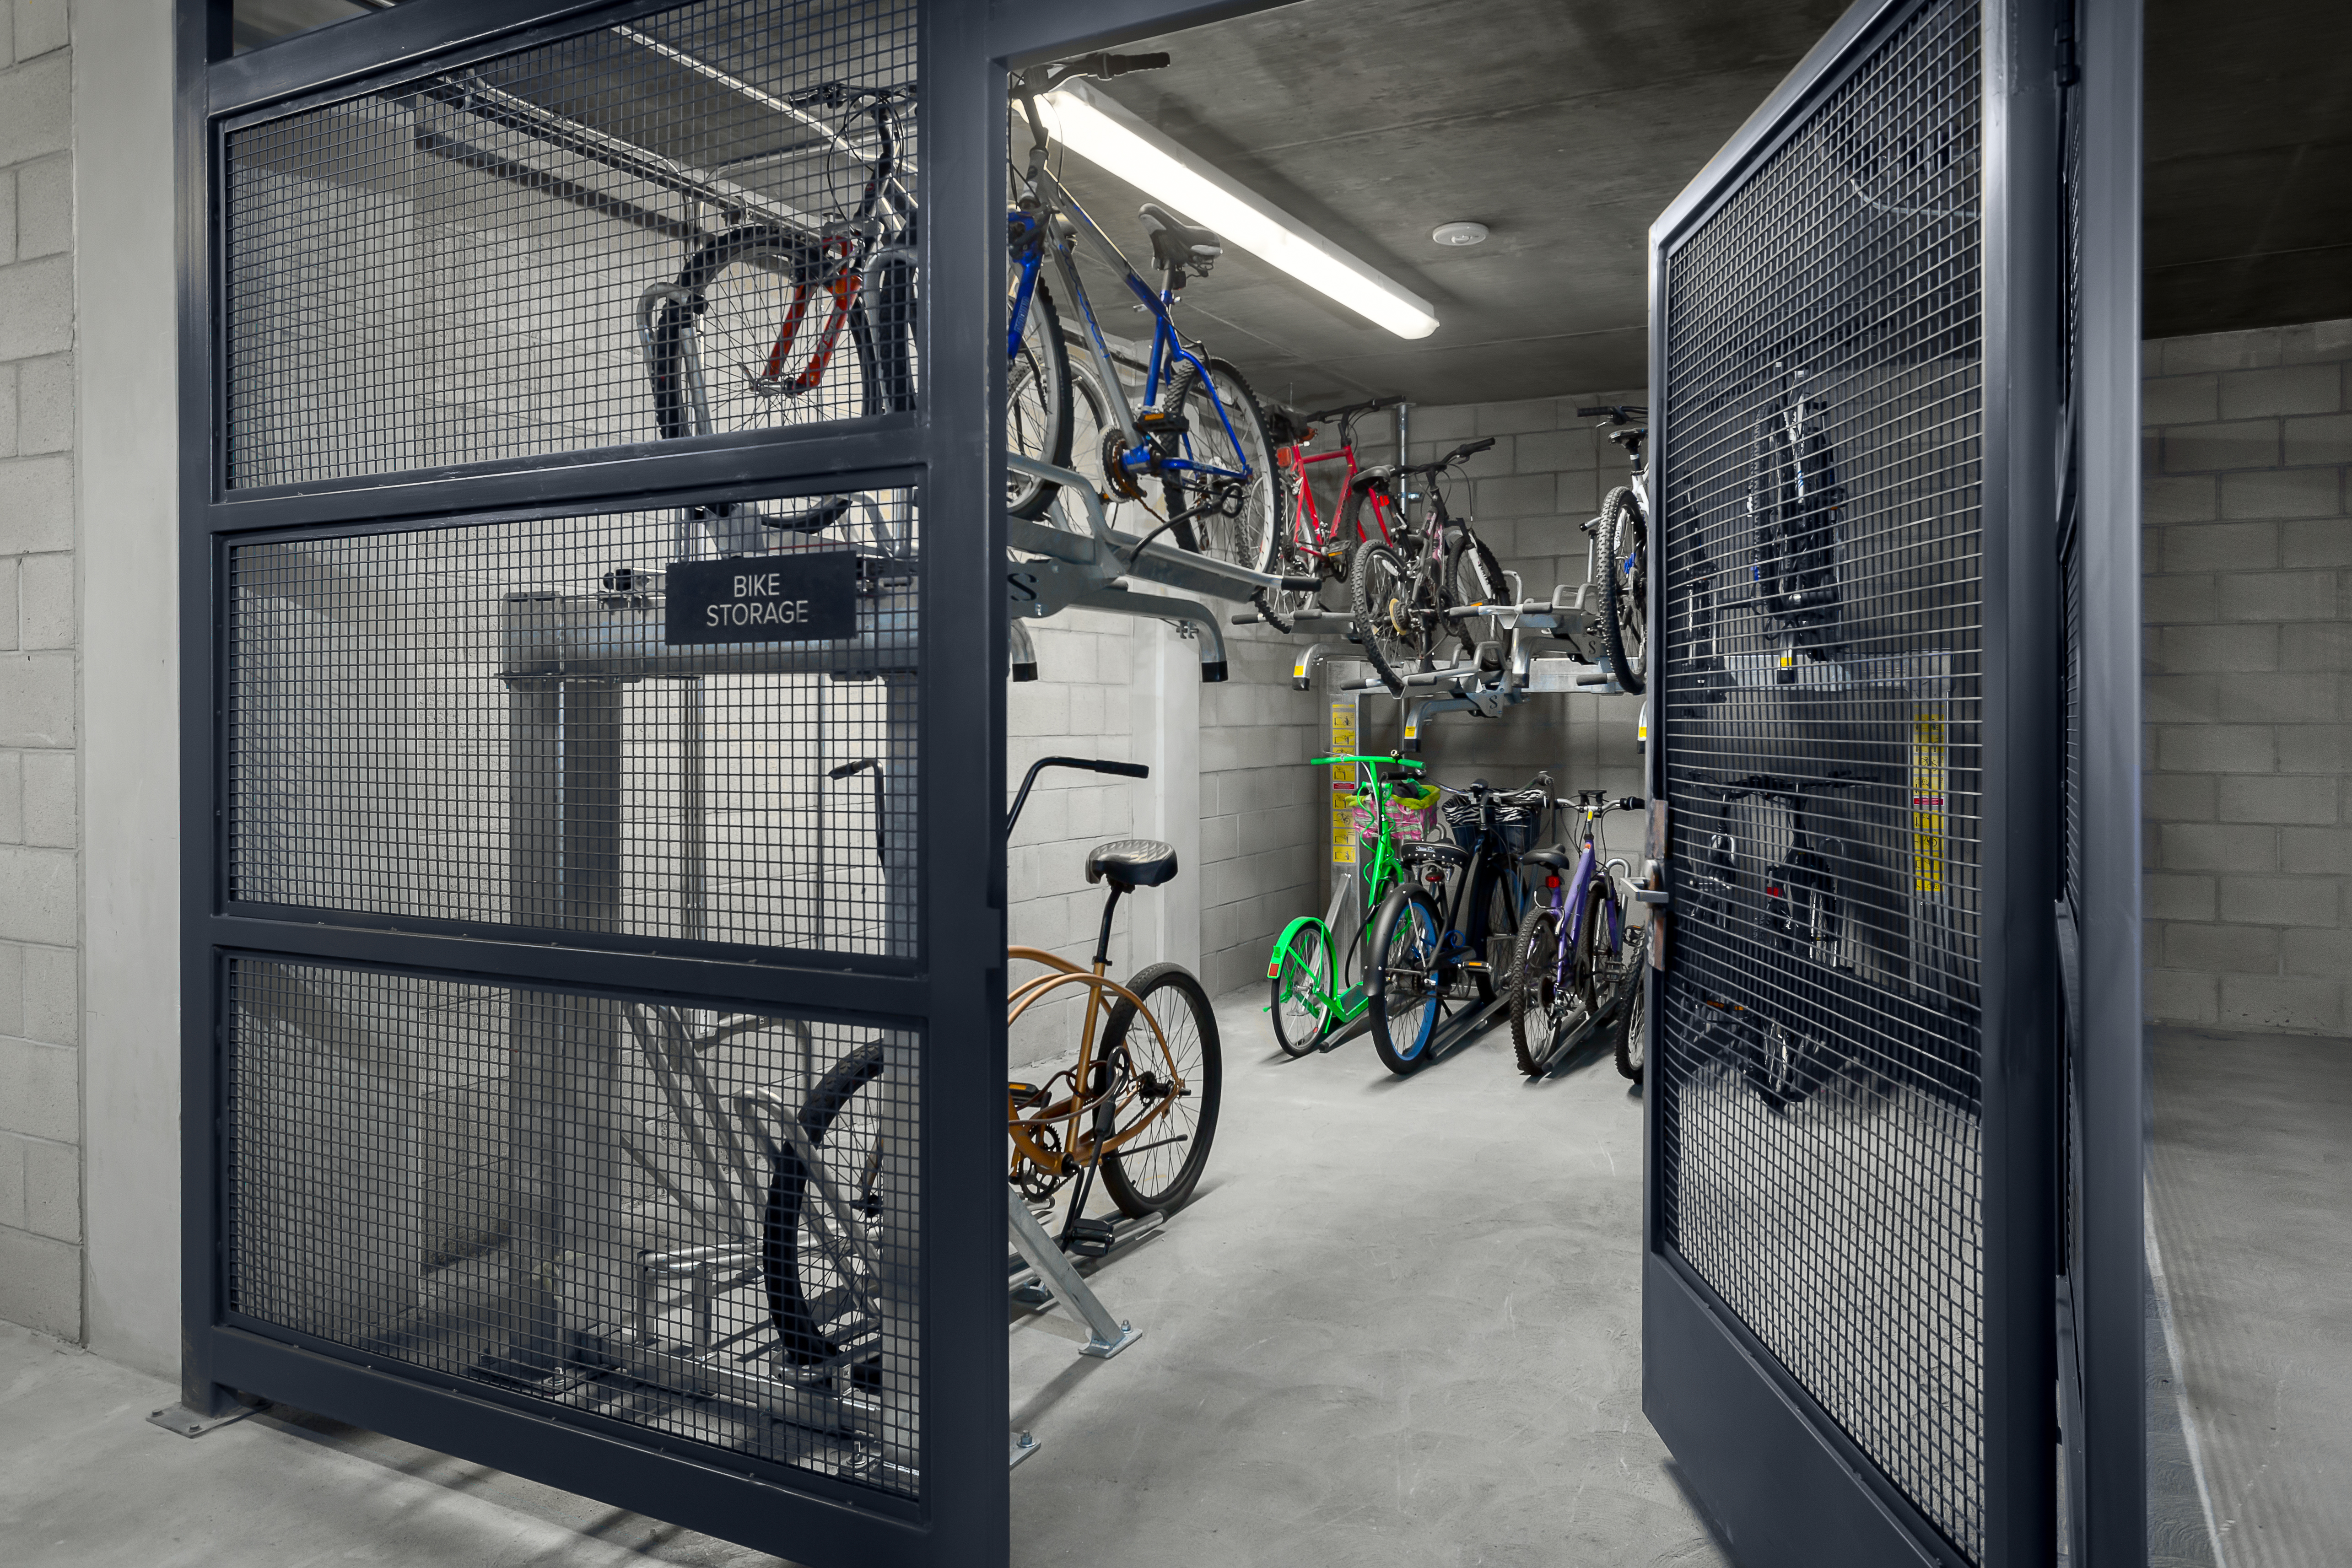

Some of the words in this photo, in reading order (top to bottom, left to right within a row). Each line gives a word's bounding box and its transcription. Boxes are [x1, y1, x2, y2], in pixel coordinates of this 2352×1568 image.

[734, 573, 780, 598] BIKE
[1008, 573, 1037, 601] S
[706, 600, 809, 627] STORAGE
[1588, 640, 1596, 654] S
[1489, 695, 1498, 709] S
